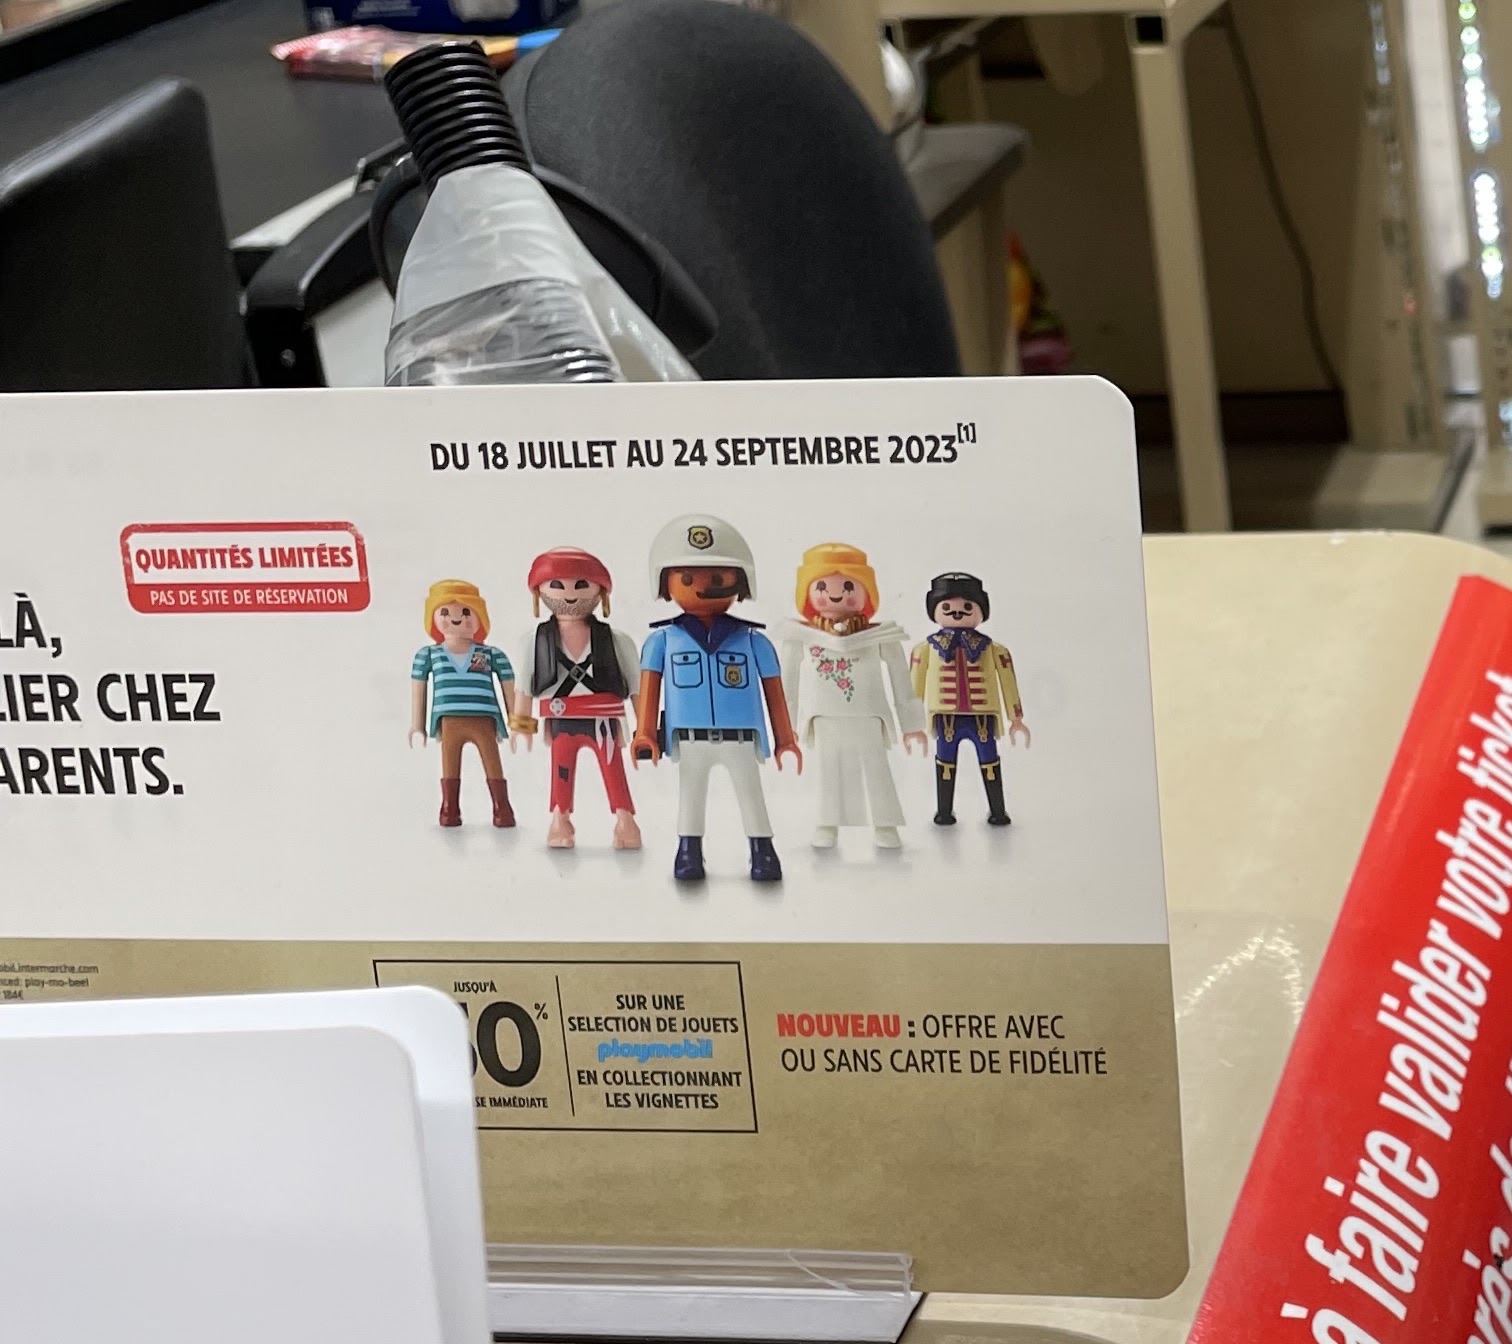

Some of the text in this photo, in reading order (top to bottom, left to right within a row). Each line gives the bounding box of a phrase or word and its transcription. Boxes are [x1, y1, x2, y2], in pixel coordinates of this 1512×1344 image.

[430, 442, 469, 471] DU
[478, 442, 508, 470] 18
[517, 441, 617, 470] JUILLET
[626, 439, 666, 468] AU
[674, 439, 708, 467] 24
[715, 435, 880, 467] SEPTEMBRE
[135, 541, 353, 572] QUANTITÉS LIMITÉES
[150, 585, 348, 606] PAS DE SITE DE RÉSERVATION
[0, 673, 221, 722] IER CHEZ
[616, 994, 685, 1010] SUR UNE
[656, 1017, 677, 1033] DE
[682, 1017, 738, 1033] JOUETS
[776, 1013, 901, 1038] NOUVEAU
[923, 1015, 997, 1040] OFFRE
[1004, 1015, 1066, 1040] AVEC
[597, 1038, 713, 1063] playmobil
[781, 1045, 1107, 1075] OU SANS CARTE DE FIDÉLITÉ
[577, 1070, 741, 1087] EN COLLECTIONNANT
[489, 1095, 548, 1108] IMMÉDIATE
[605, 1092, 719, 1109] LES VIGNETTES
[1304, 1130, 1440, 1321] faire
[1378, 919, 1492, 1141] valider
